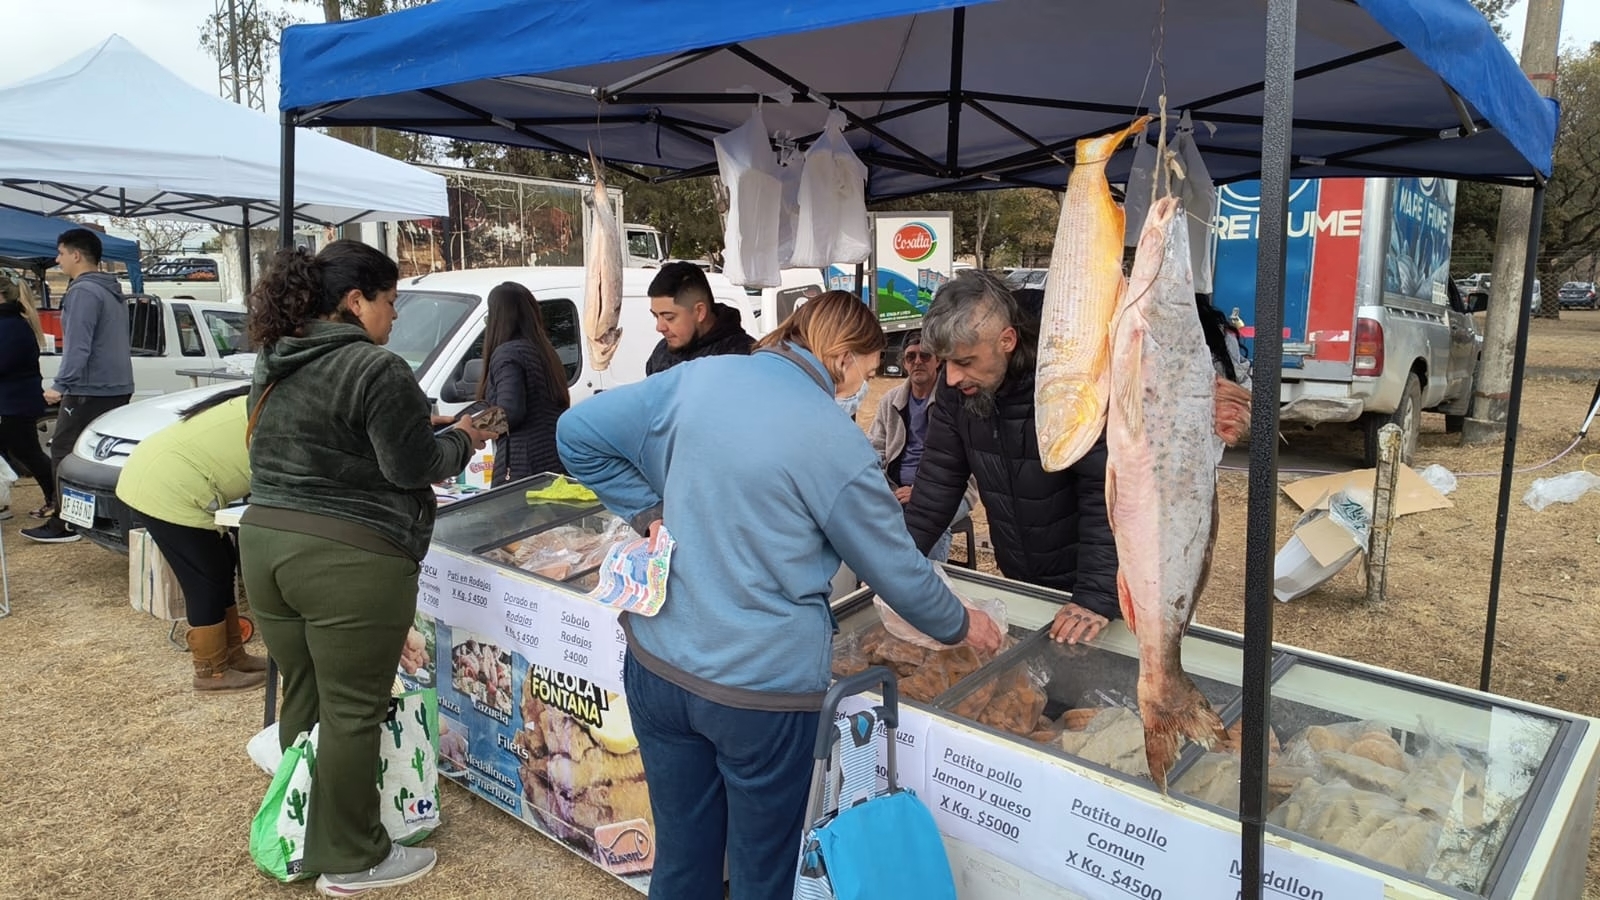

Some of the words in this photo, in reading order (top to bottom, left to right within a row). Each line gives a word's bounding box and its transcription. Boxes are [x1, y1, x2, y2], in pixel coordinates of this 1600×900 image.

[895, 231, 930, 250] Cosalta
[420, 561, 438, 577] Pacu
[460, 575, 468, 583] en
[468, 576, 491, 591] Rodajas
[473, 594, 488, 606] 4500
[503, 592, 528, 607] Dorado
[529, 601, 538, 610] en
[506, 610, 533, 626] Rodajas
[560, 611, 590, 628] Sabalo
[521, 633, 539, 646] 4500
[560, 630, 592, 649] Rodajas
[563, 649, 589, 665] $4000
[470, 693, 508, 726] Cazuela
[532, 676, 600, 725] FONTANA
[497, 731, 529, 760] Filets
[464, 751, 516, 789] Medallones
[944, 747, 984, 774] Patita
[987, 768, 1022, 789] pollo
[477, 778, 516, 807] merluza
[932, 767, 976, 794] Jamon
[979, 787, 988, 801] y
[990, 793, 1031, 818] queso
[940, 795, 950, 809] X
[952, 800, 973, 820] Kg.
[977, 810, 1020, 839] $5000
[1071, 798, 1121, 828] Patita
[1123, 822, 1168, 847] pollo
[1087, 832, 1145, 867] Comun
[1066, 849, 1079, 865] X
[1081, 856, 1105, 878] Kg.
[1111, 869, 1162, 900] $4500
[1229, 859, 1324, 900] Mdallon
